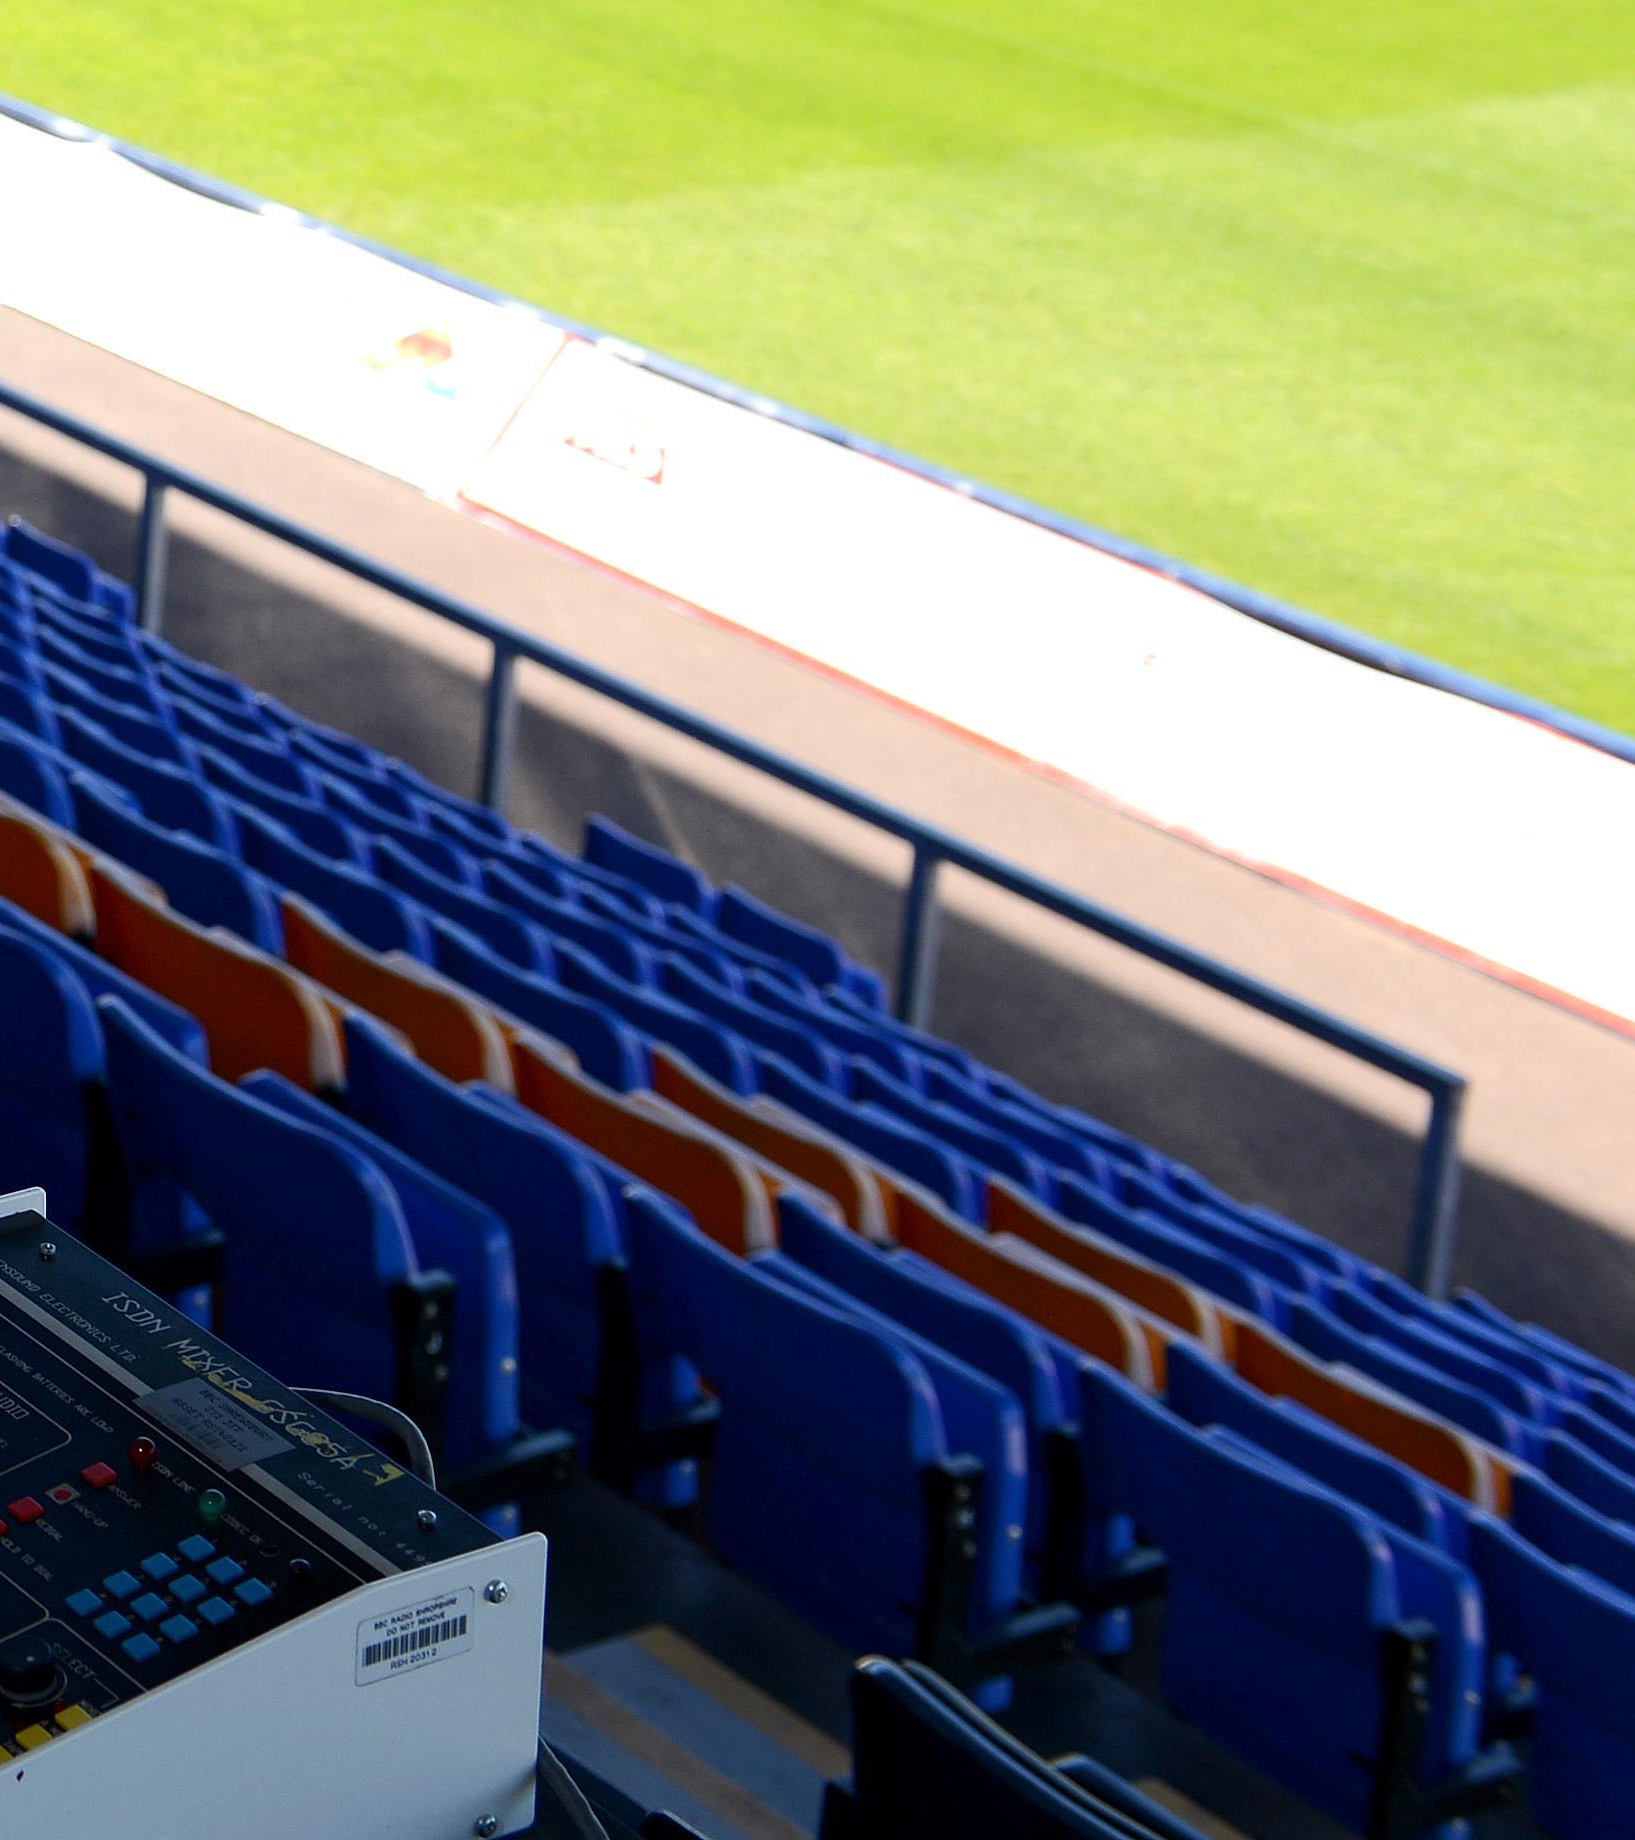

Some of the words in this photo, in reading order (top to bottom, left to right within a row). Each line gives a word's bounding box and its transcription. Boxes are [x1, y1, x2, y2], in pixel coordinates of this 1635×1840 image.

[39, 1294, 112, 1343] ELECTRONICS
[102, 1291, 171, 1336] ISDN
[160, 1337, 253, 1390] MIXER
[374, 1620, 389, 1631] BBC
[391, 1612, 413, 1624] RADIO
[386, 1626, 398, 1637] DO
[399, 1621, 415, 1632] NOT
